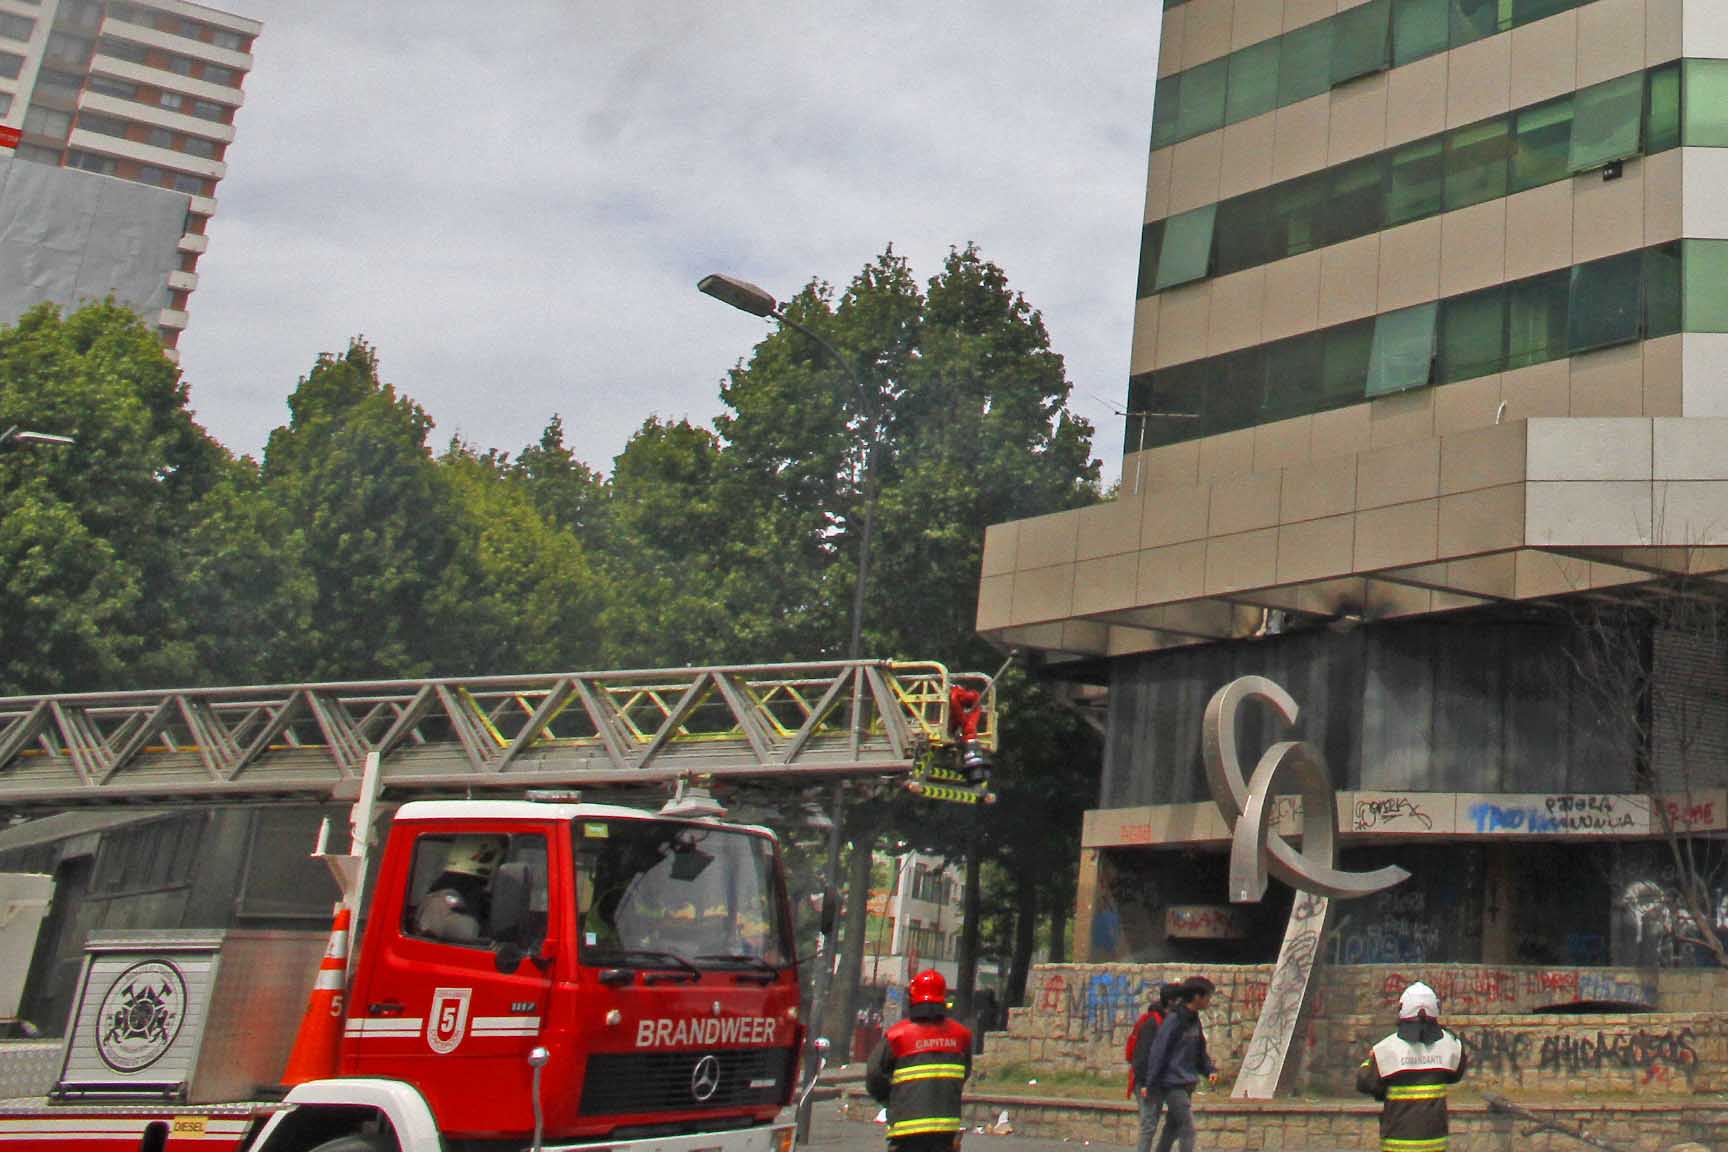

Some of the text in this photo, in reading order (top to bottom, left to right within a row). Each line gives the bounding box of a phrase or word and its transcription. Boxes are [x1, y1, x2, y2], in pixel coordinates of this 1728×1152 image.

[328, 996, 343, 1016] 5
[441, 1007, 456, 1032] 5
[636, 1017, 776, 1047] BRANDWEER
[175, 1121, 205, 1132] DIESEL
